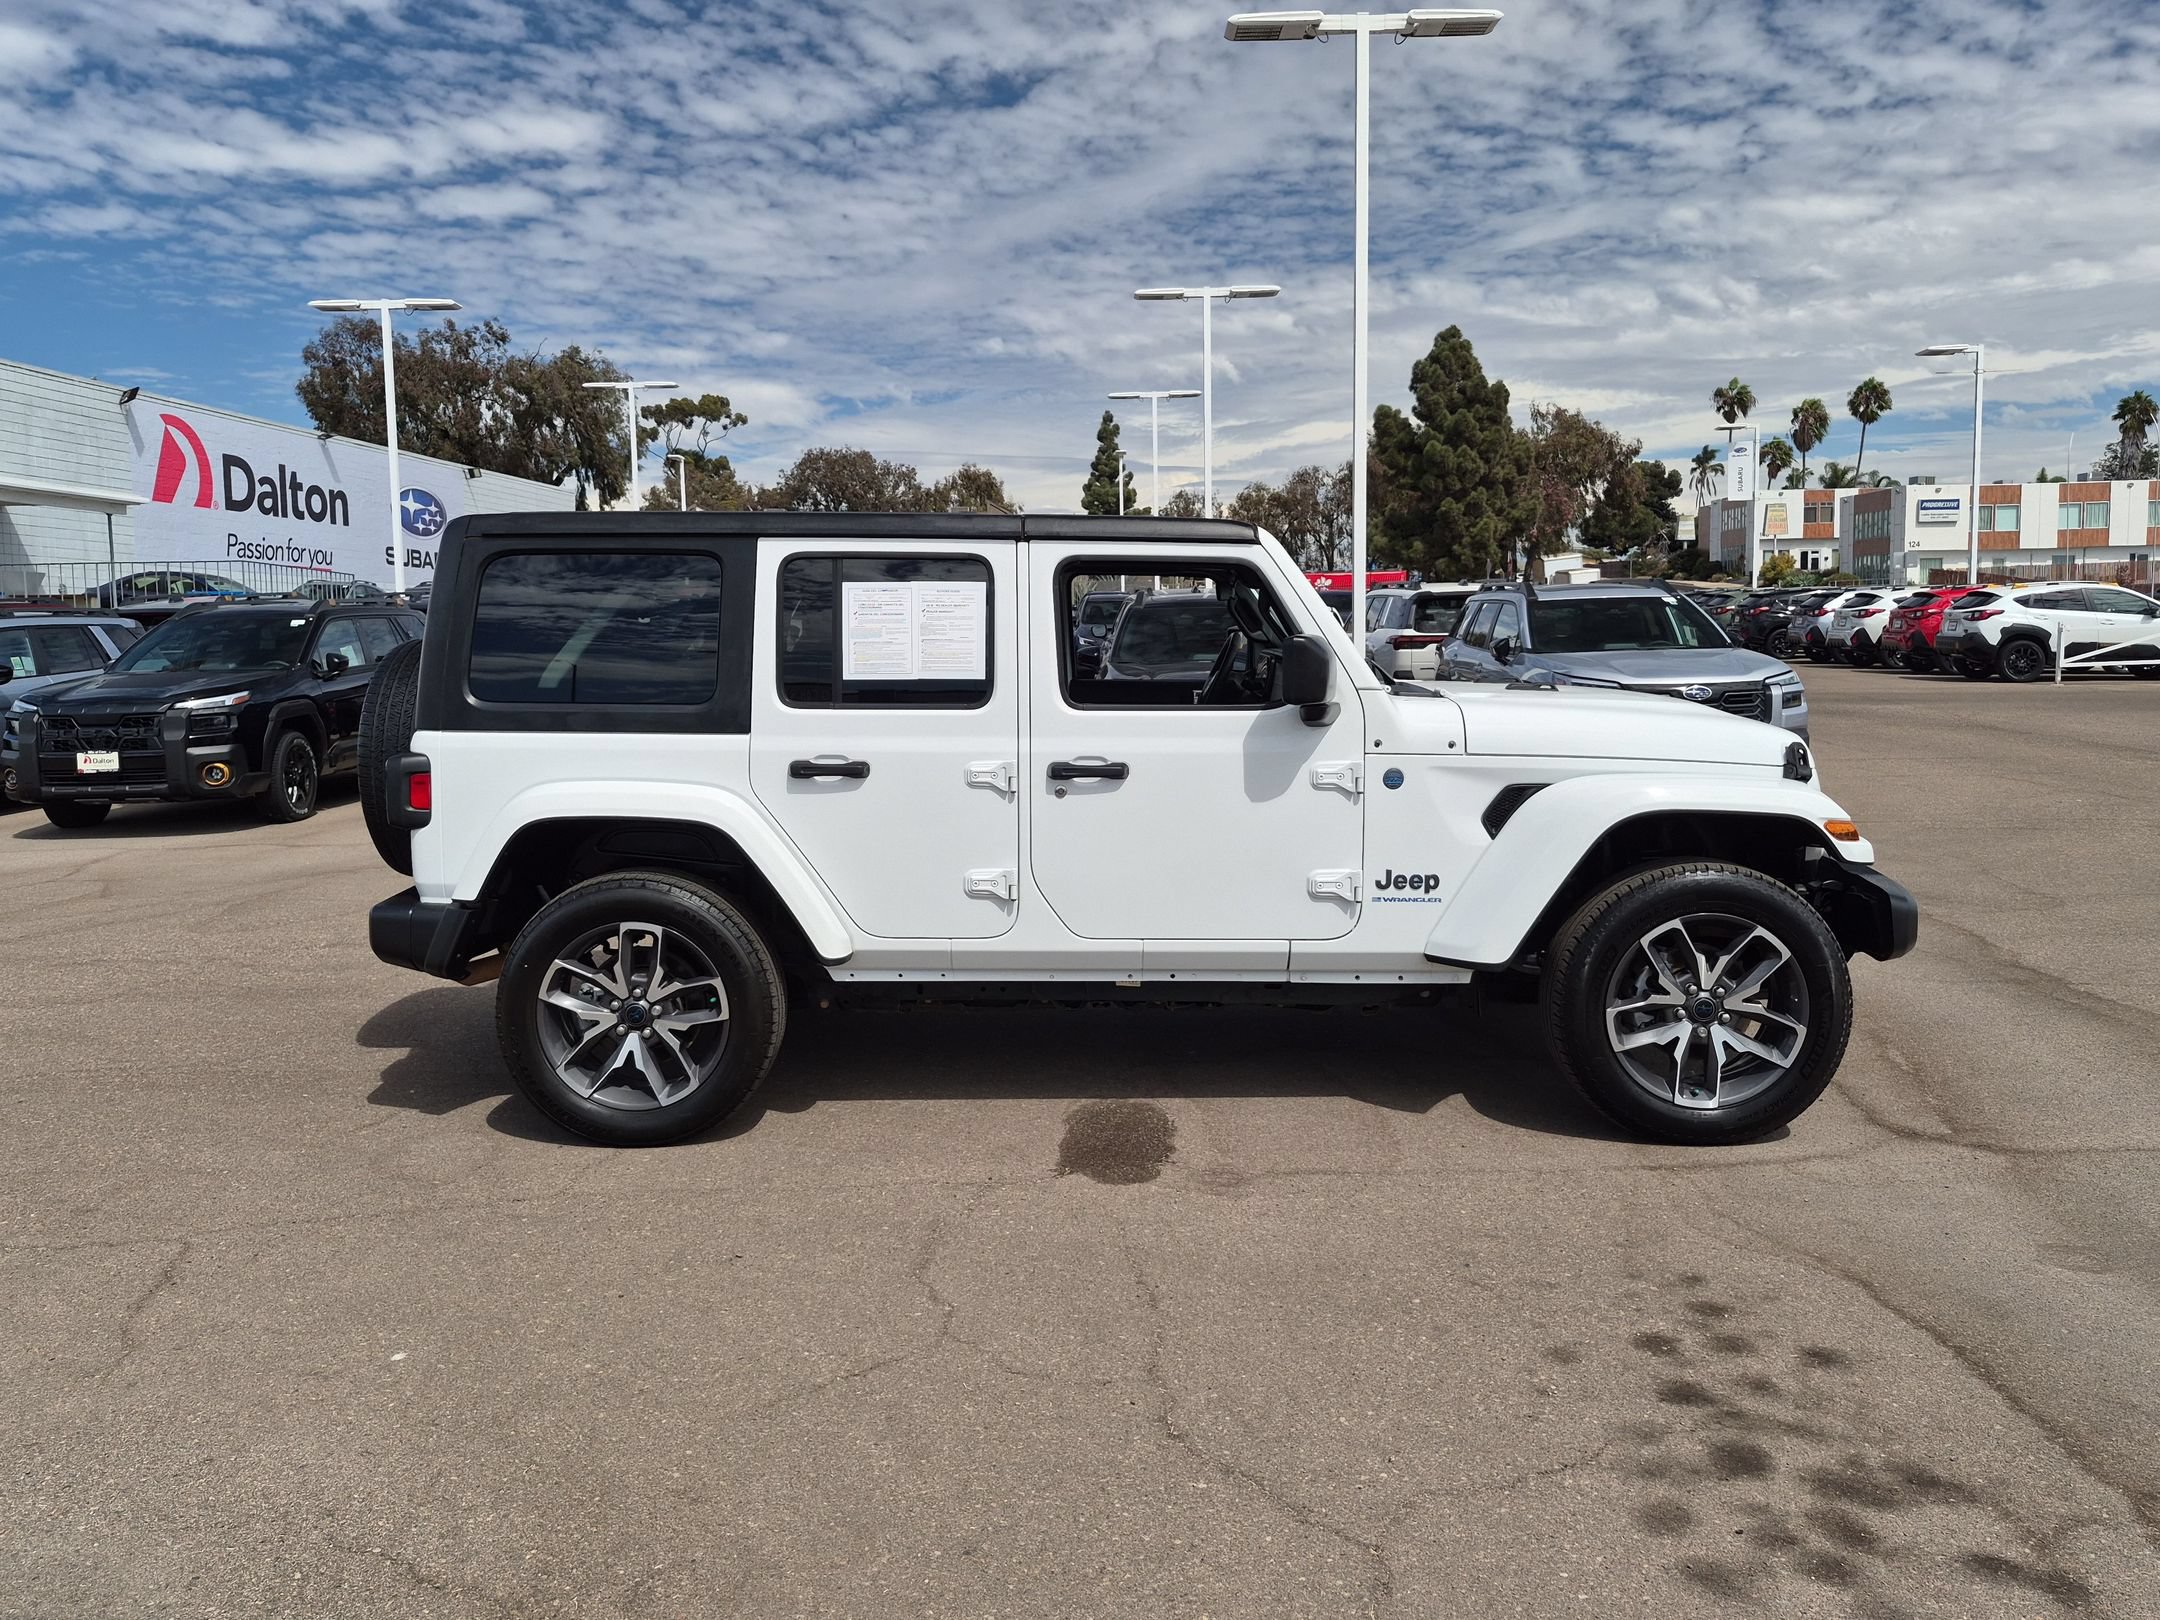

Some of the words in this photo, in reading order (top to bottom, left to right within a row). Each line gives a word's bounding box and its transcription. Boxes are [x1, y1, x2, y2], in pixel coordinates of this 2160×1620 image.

[222, 453, 350, 527] Dalton
[227, 532, 284, 562] Passion
[286, 537, 307, 564] for
[308, 549, 333, 570] you
[385, 546, 438, 570] SBA
[92, 757, 115, 765] Dalton
[1375, 869, 1440, 894] Jeep
